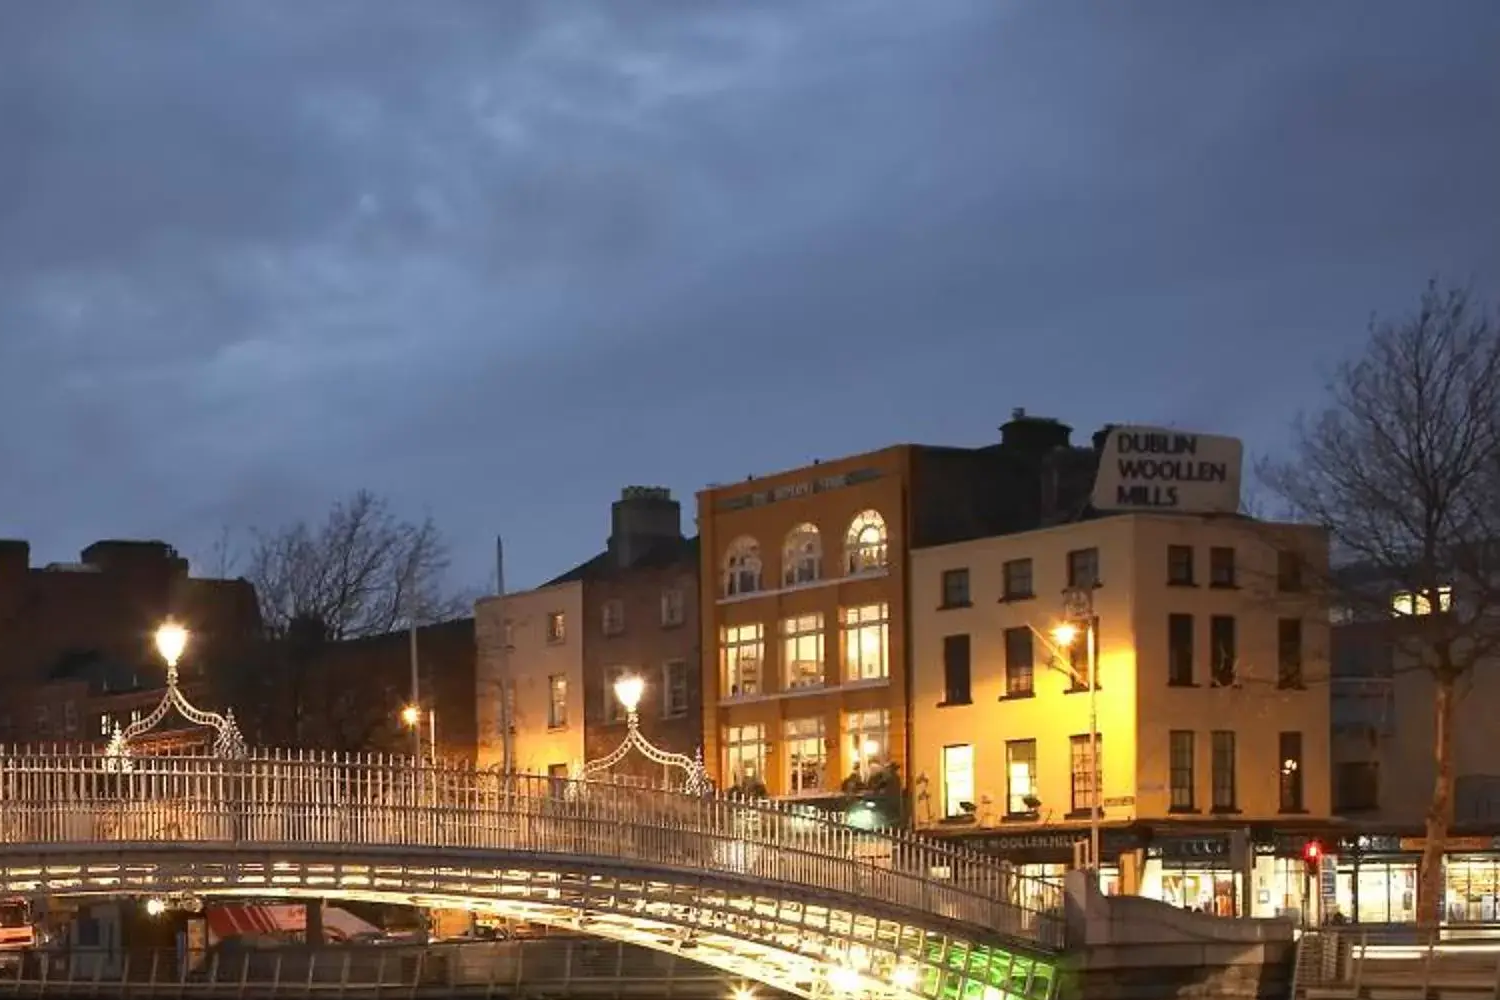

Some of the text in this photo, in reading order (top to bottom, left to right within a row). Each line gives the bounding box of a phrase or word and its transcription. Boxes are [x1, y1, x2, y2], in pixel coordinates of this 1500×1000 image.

[1117, 432, 1197, 455] DUBLIN
[1117, 458, 1226, 483] WOOLLEN
[1116, 485, 1178, 506] MILLS
